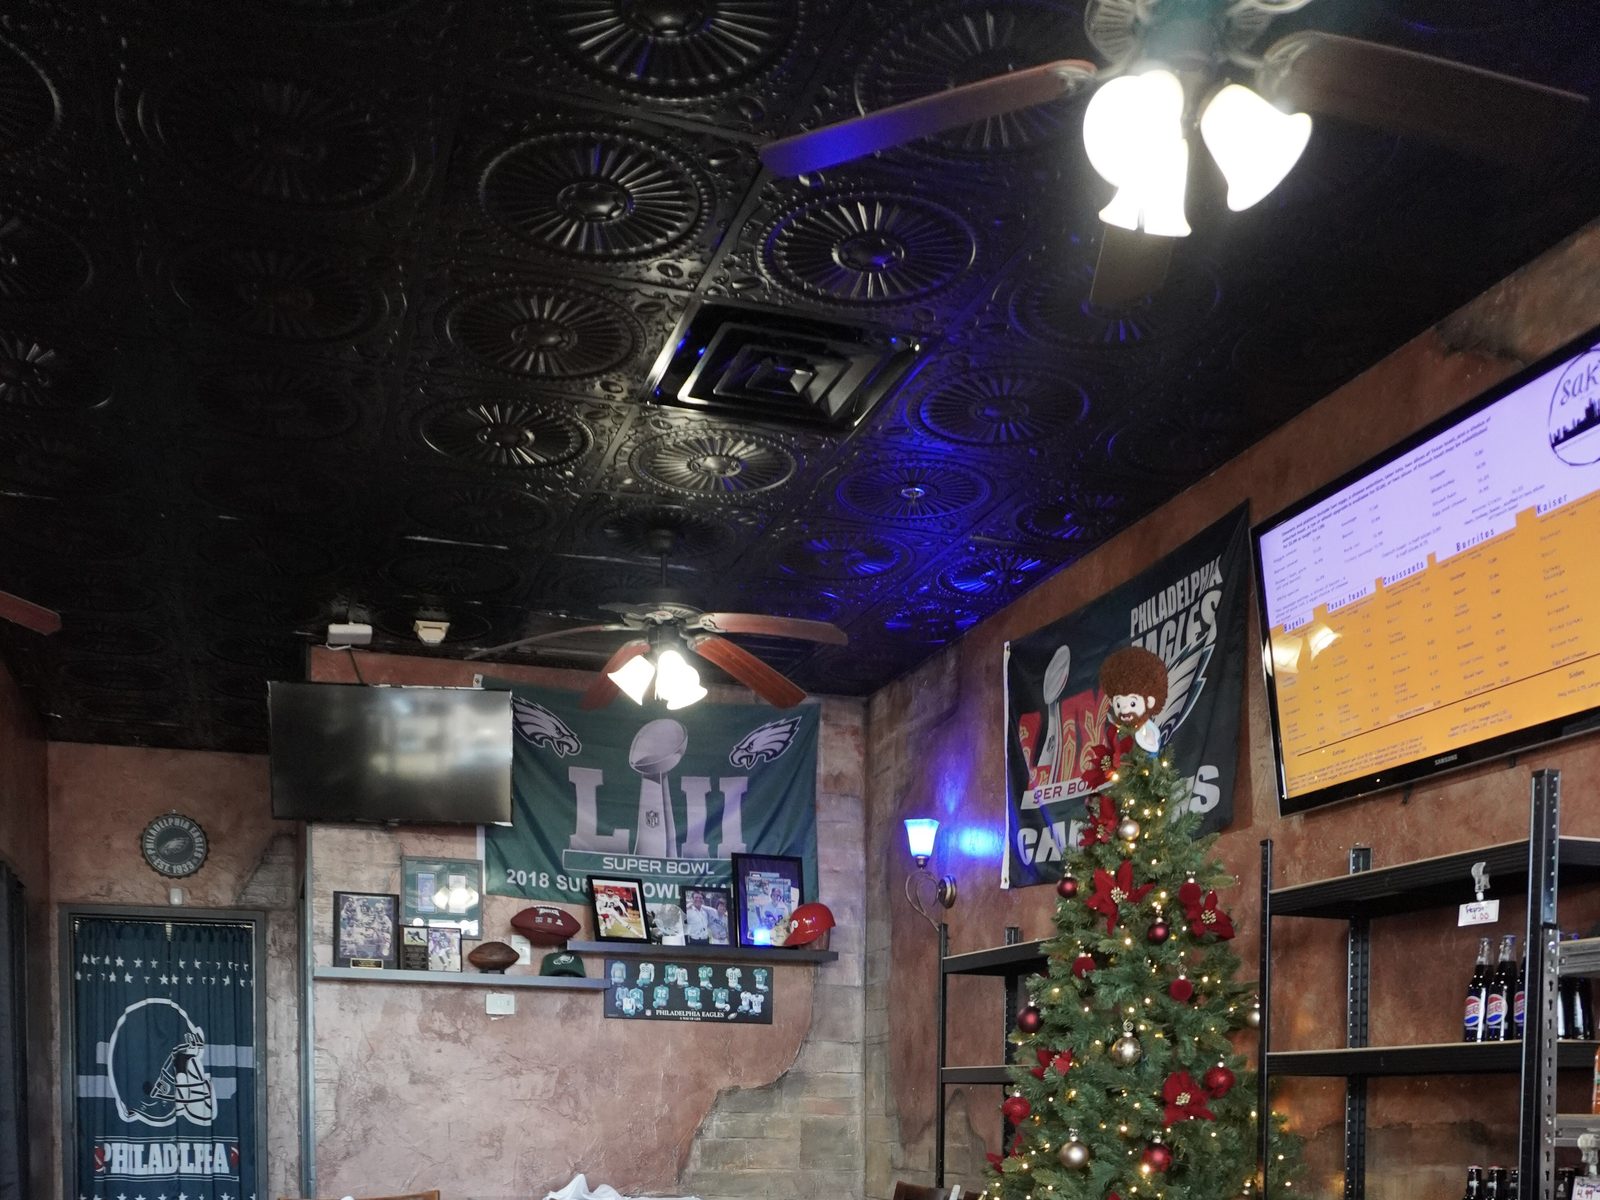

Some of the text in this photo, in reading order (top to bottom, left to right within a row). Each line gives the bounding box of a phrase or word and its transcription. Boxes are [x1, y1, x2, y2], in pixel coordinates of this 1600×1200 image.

[1536, 493, 1568, 514] Kaiser
[1456, 528, 1495, 552] Burritos
[1434, 754, 1458, 765] SAMSUNG
[145, 817, 204, 858] PHILADELPHIA EAGLES
[153, 858, 195, 874] EST. 1933
[602, 857, 716, 875] SUPER BOWL
[506, 869, 550, 888] 2018
[642, 882, 681, 900] OWL
[655, 1009, 701, 1017] PHILADELPHIA
